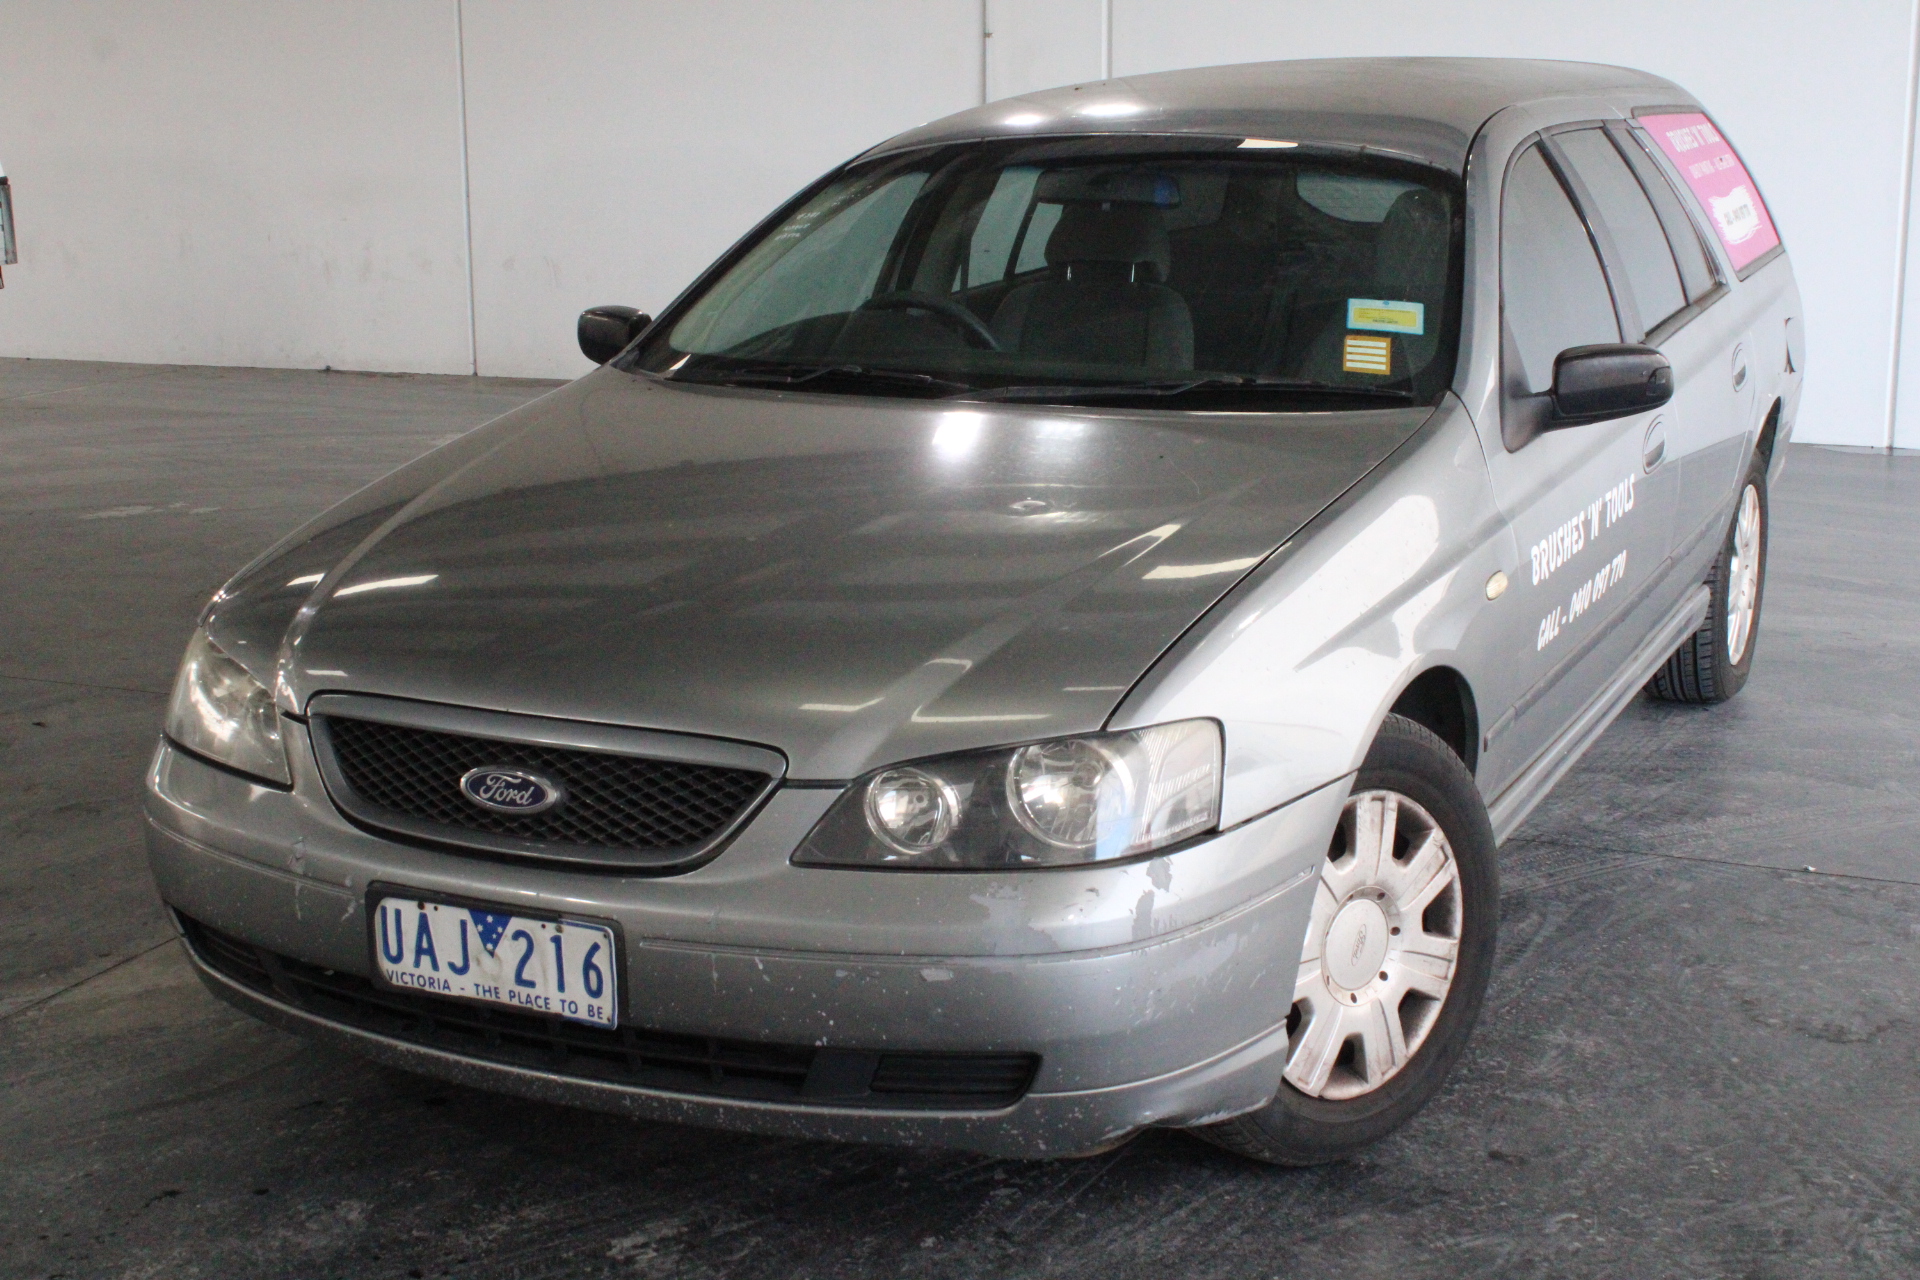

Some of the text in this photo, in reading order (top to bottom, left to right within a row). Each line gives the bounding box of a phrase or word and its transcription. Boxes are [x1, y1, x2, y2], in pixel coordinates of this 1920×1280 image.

[1531, 510, 1585, 585] BRUSHES
[1605, 473, 1635, 527] TOOLS
[1537, 605, 1561, 651] CALL
[479, 773, 535, 805] Ford
[380, 905, 604, 999] UAJ 216
[386, 968, 451, 992] VICTORIA
[474, 983, 501, 999] THE
[508, 989, 551, 1011] PLACE
[560, 999, 578, 1015] TO
[587, 1004, 604, 1020] BE
